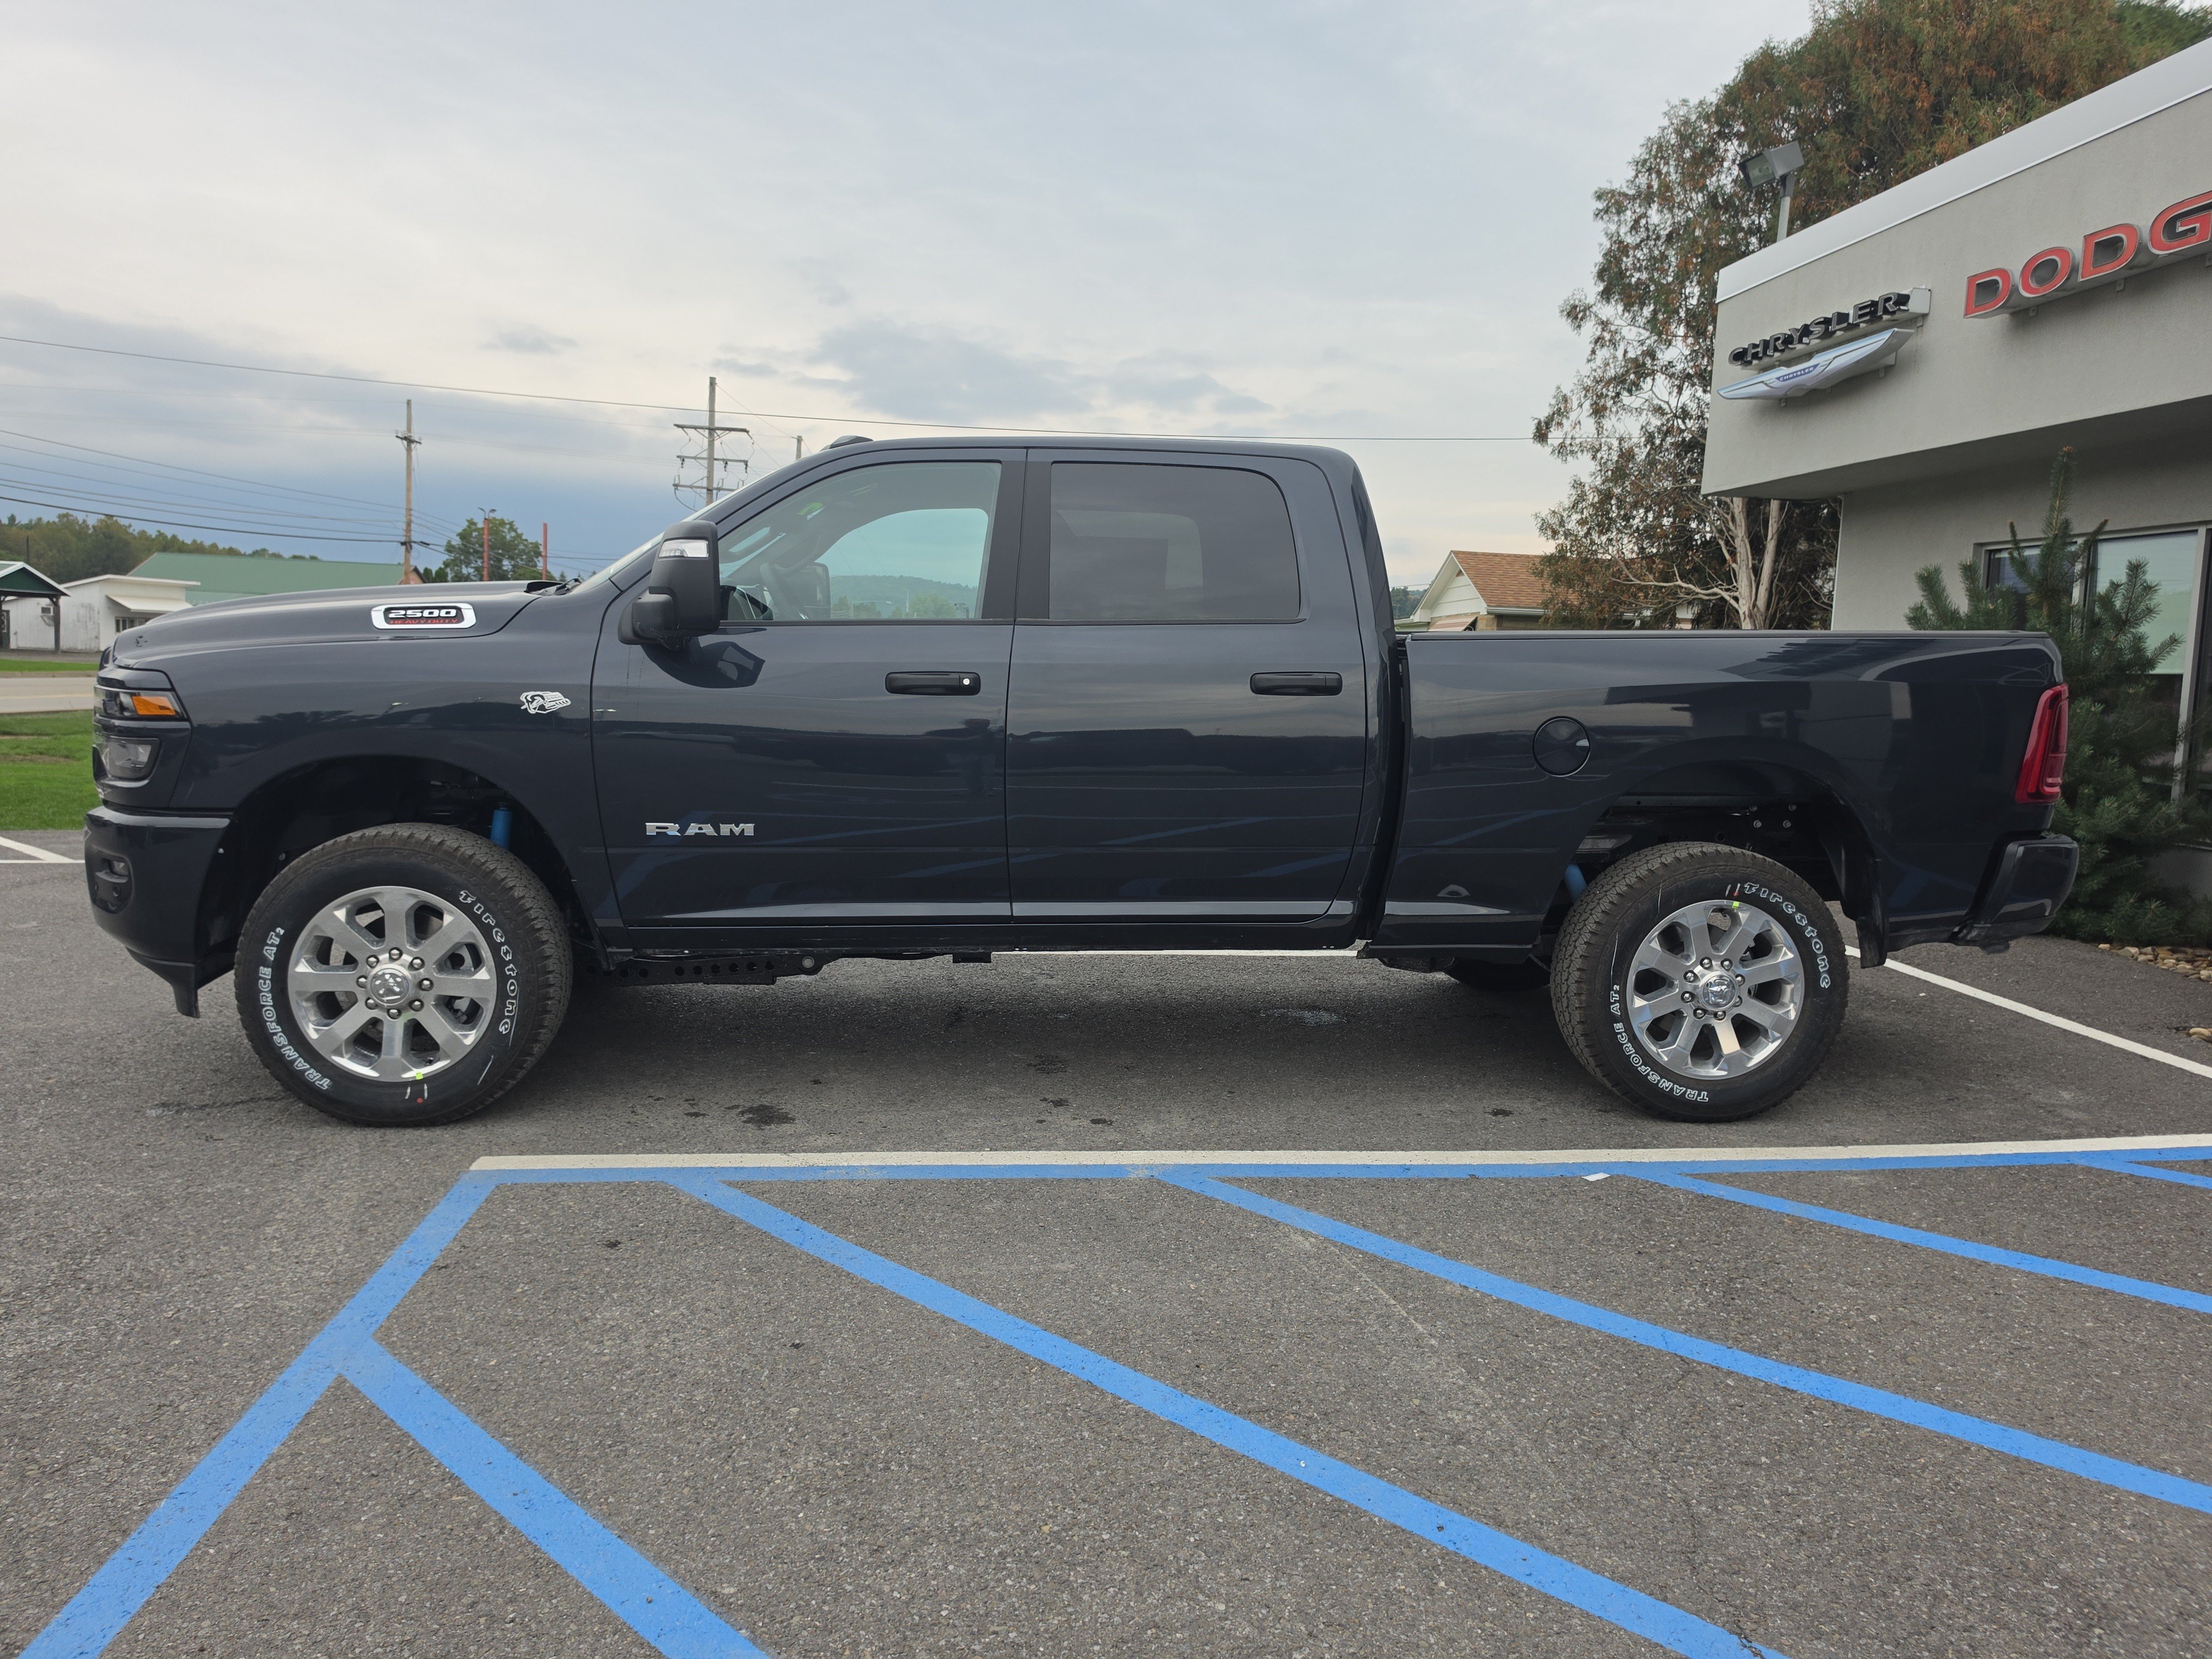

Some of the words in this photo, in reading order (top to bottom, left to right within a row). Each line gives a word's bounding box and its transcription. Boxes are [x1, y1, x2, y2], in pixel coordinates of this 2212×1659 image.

[1728, 292, 1902, 366] CHRYSLER
[1779, 366, 1814, 381] CHRYSLER
[388, 608, 457, 618] 2500
[645, 822, 755, 837] RAM
[459, 890, 518, 1034] Firestone
[1744, 882, 1831, 989] Firestone
[258, 966, 331, 1090] TRANSFORCE
[1613, 1022, 1709, 1103] TRANSFORCE
